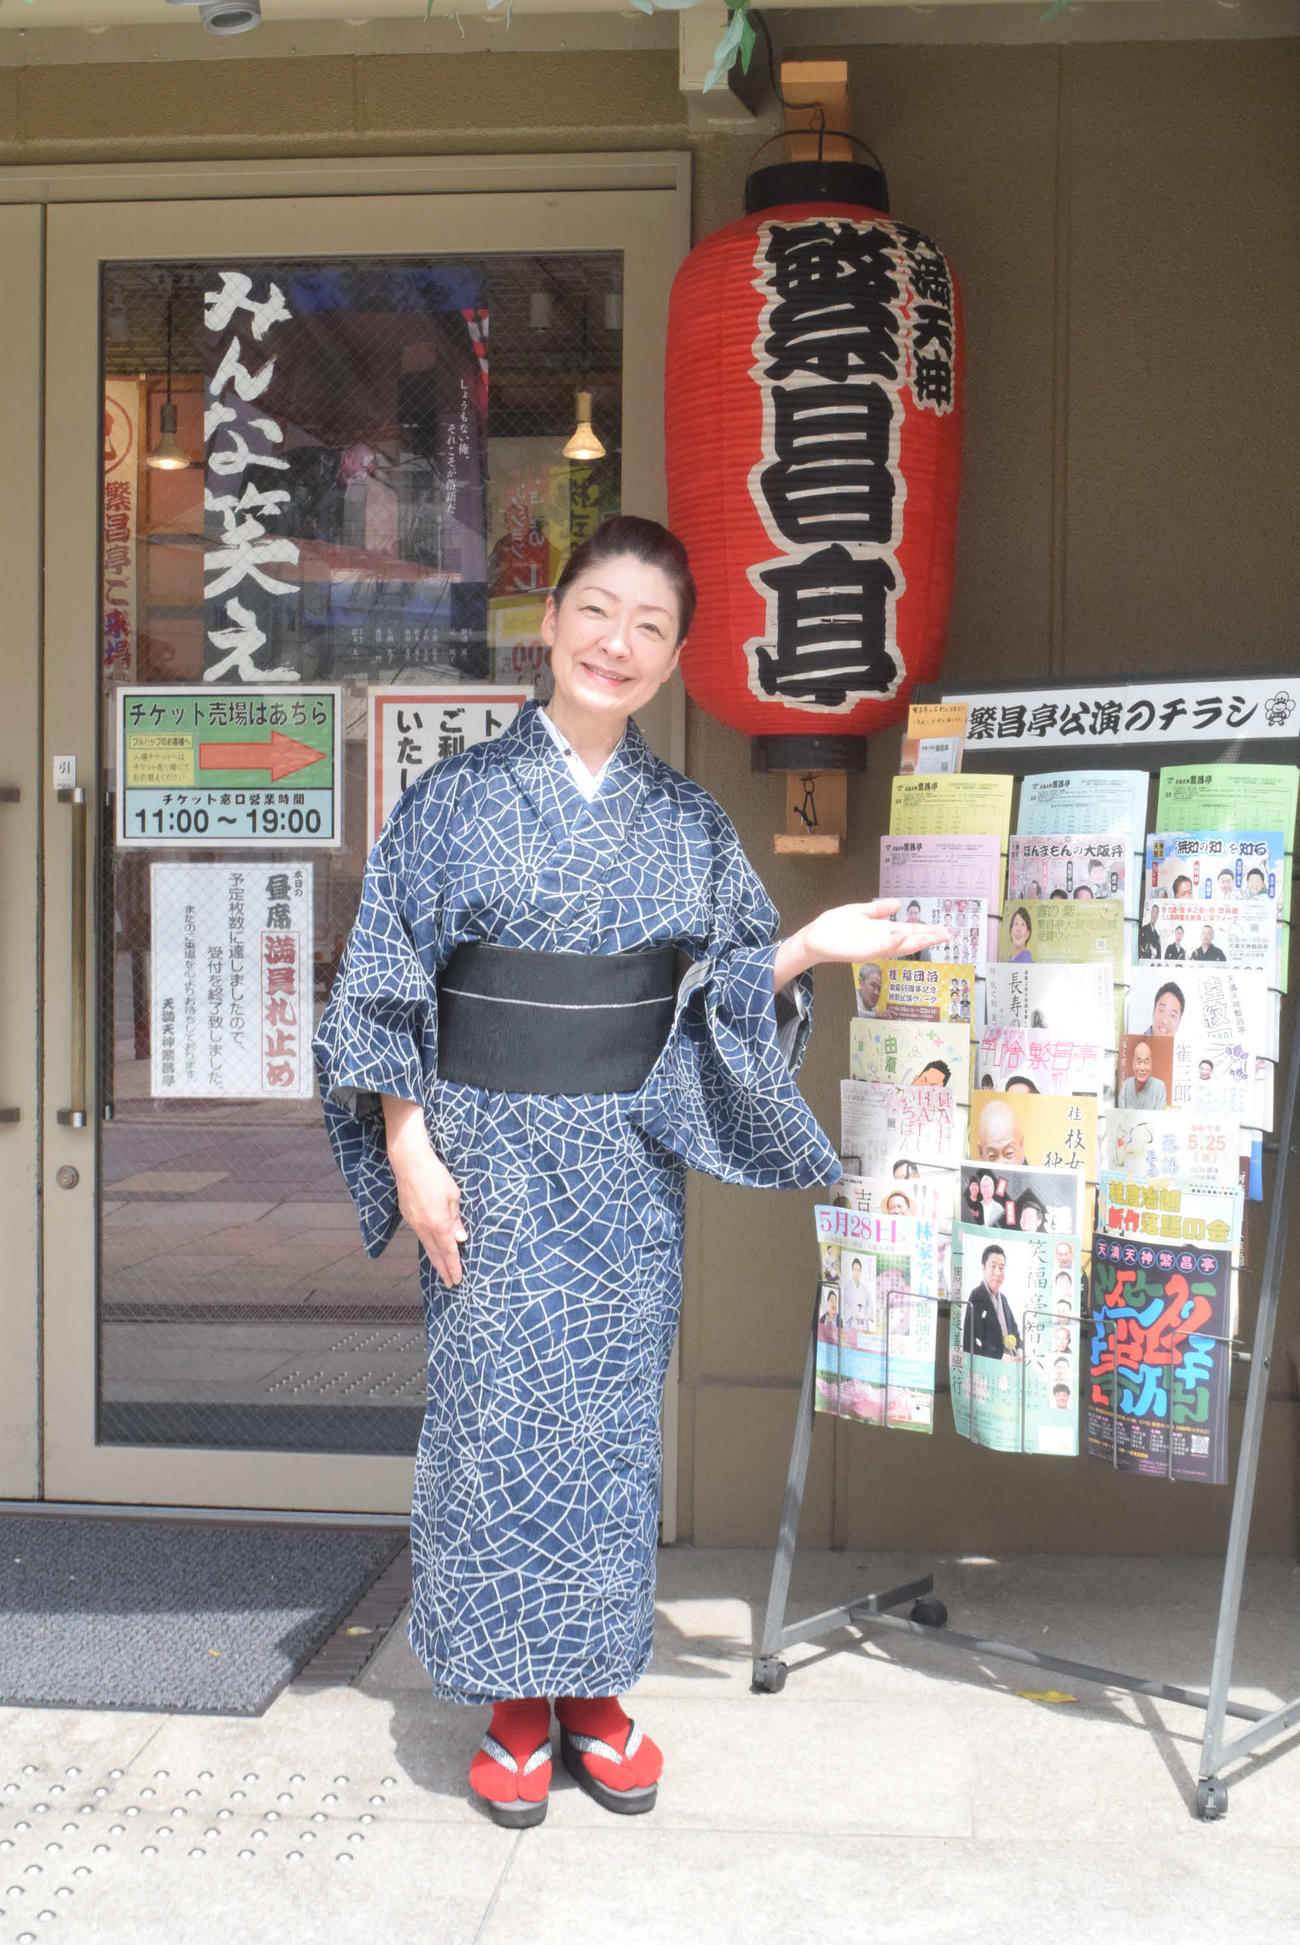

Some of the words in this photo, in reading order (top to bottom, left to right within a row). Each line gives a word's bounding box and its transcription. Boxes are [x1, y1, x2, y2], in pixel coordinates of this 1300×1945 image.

[203, 271, 301, 682] みんな笑え
[755, 220, 901, 706] 繁昌亭
[129, 701, 328, 726] チケット売場はあちら
[966, 694, 1260, 741] 繁昌亭公演のチラシ
[162, 793, 305, 806] チケット窓口営業時間
[135, 808, 209, 834] 11:00
[246, 808, 321, 834] 19:00
[1023, 844, 1123, 858] ほんまもんの大阪弁
[1174, 840, 1267, 856] 「無知の知」を知る
[293, 870, 304, 898] 本日の
[265, 873, 291, 930] 昼席
[228, 872, 246, 1051] 予定枚数に達しましたので、
[207, 945, 225, 1091] 受付を終了致しました。
[264, 934, 297, 1088] 満員札止め
[161, 997, 176, 1088] 天満天神繁昌亭
[1187, 1134, 1227, 1152] 5.25
[818, 1210, 897, 1244] 5月28日
[1096, 1240, 1217, 1274] 天満天神繁昌亭
